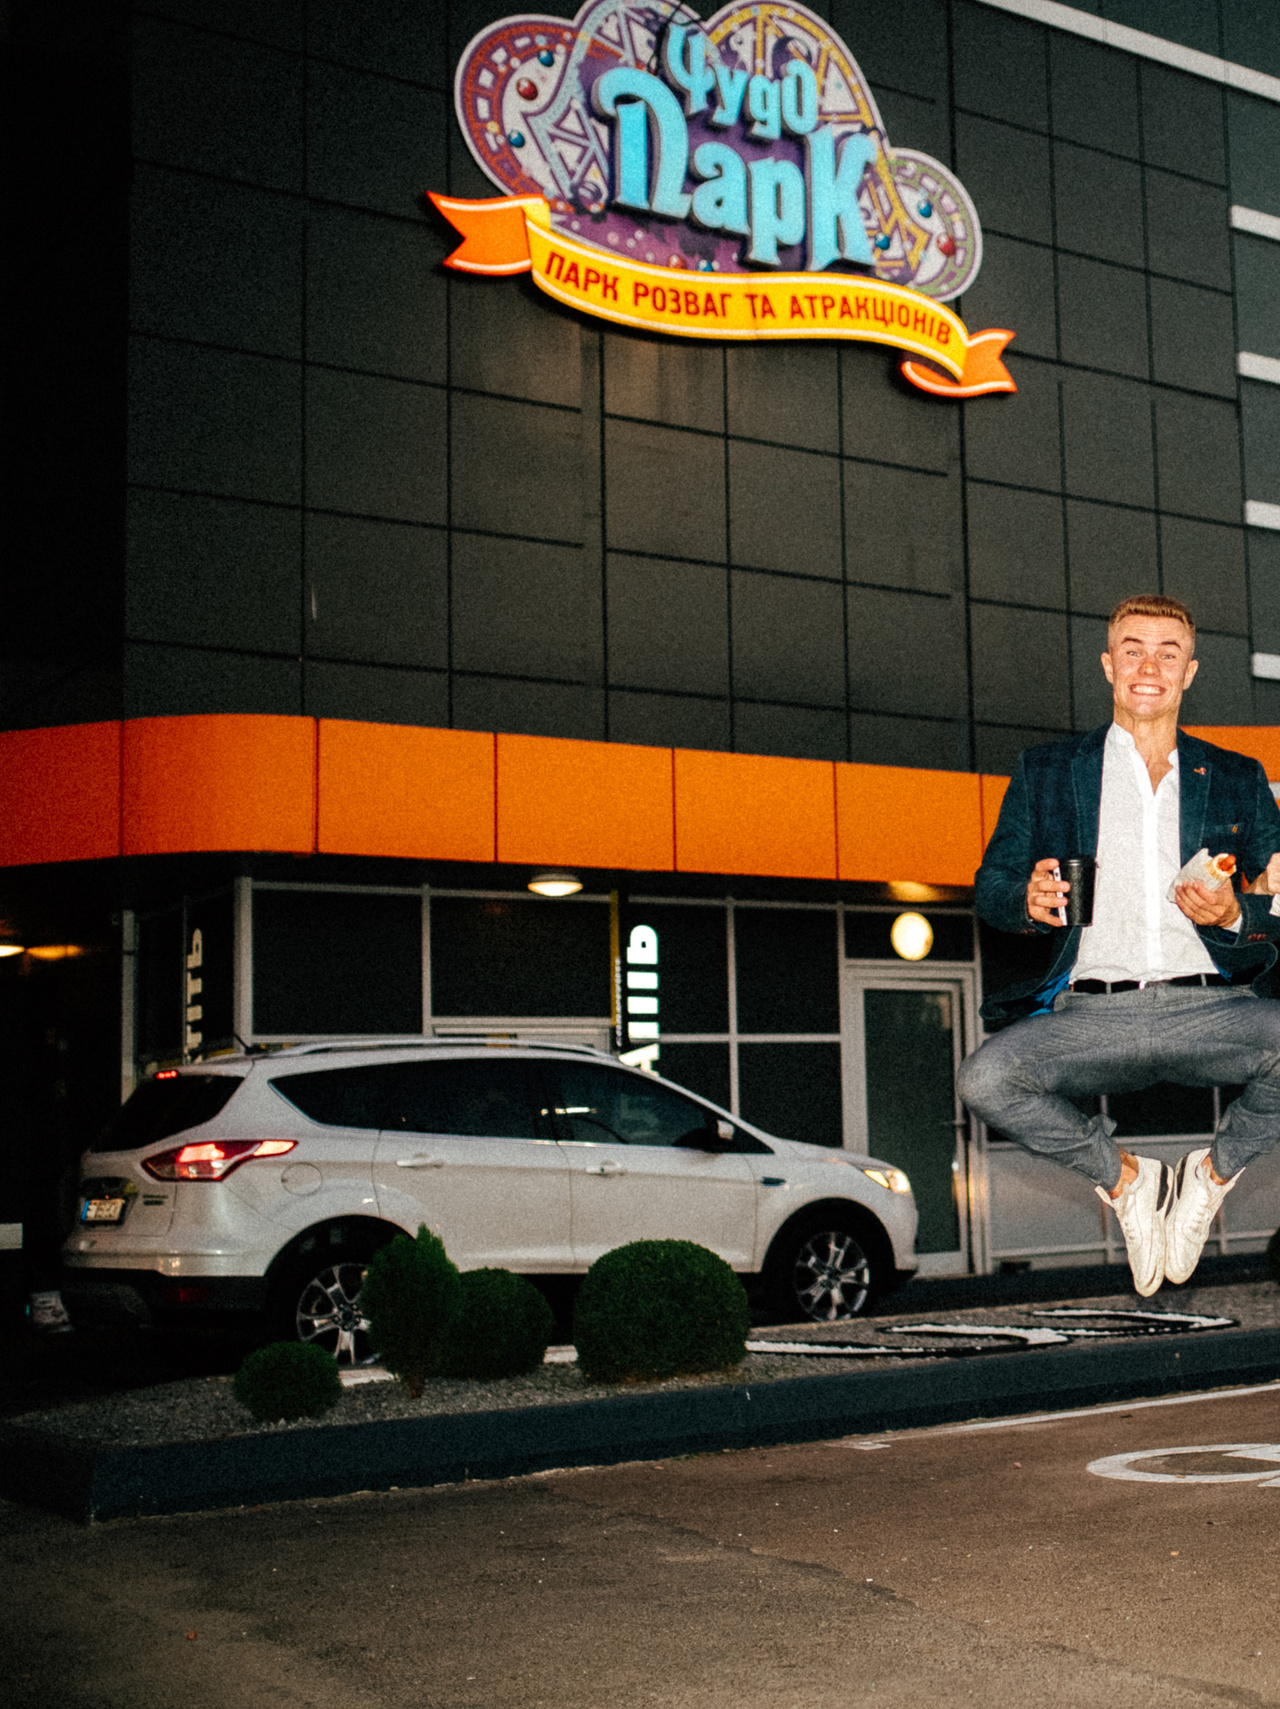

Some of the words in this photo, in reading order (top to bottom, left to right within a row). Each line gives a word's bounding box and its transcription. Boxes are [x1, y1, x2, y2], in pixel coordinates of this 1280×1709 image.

[666, 22, 817, 140] Чудо
[544, 250, 619, 302] ПАРК
[633, 282, 731, 318] РОЗВАГ
[744, 293, 776, 320] ТА
[790, 294, 952, 346] АТРАКЦІОНІВ
